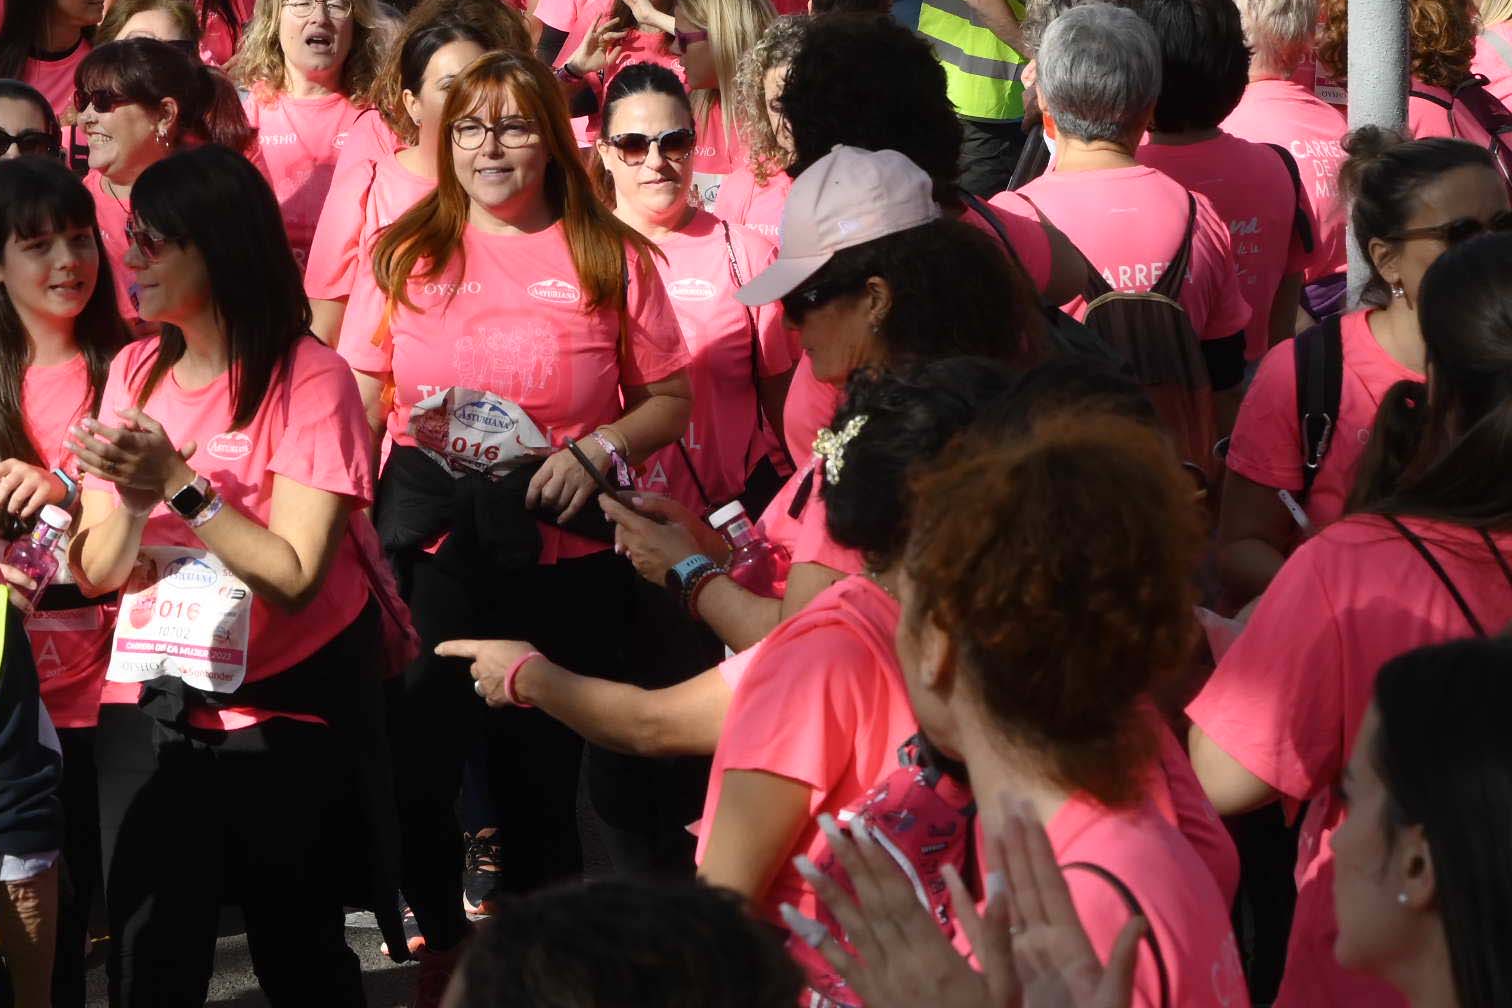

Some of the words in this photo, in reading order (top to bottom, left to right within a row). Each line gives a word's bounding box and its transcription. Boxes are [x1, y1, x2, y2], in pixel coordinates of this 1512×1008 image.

[1291, 140, 1341, 159] CARRE
[460, 408, 509, 430] ASTURIANA
[451, 437, 501, 461] 016
[158, 600, 201, 622] 016
